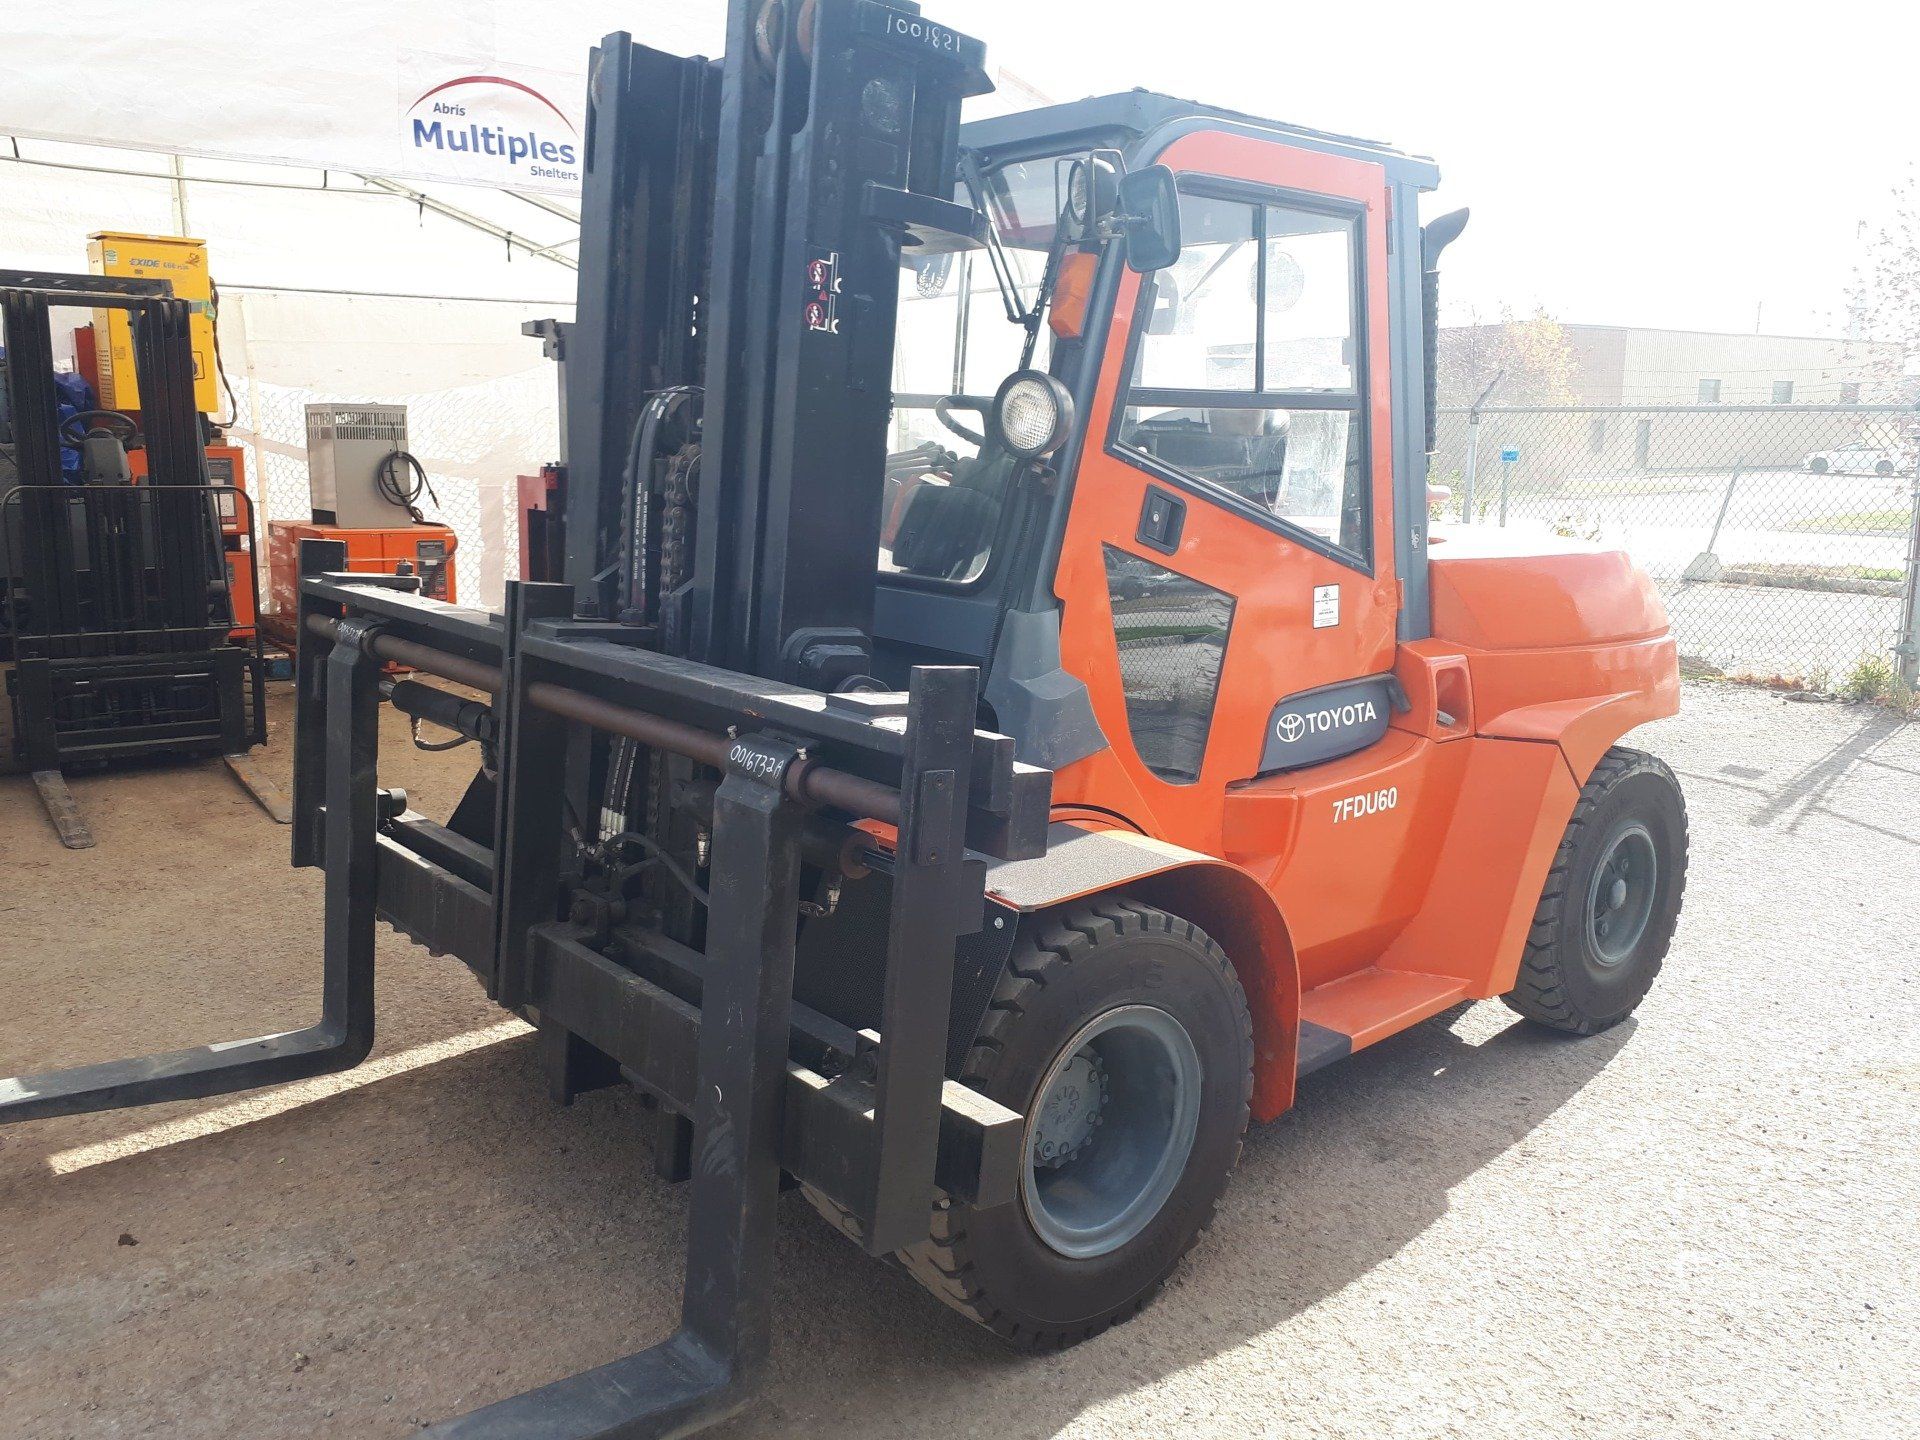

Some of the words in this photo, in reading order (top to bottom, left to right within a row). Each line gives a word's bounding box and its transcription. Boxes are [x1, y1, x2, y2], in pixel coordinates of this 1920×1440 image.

[433, 102, 466, 117] Abris
[413, 118, 576, 165] Multiples
[530, 165, 579, 181] Shelters
[129, 258, 160, 269] EXIDE
[1306, 701, 1377, 734] TOYOTA
[1332, 786, 1398, 824] 7FDU60
